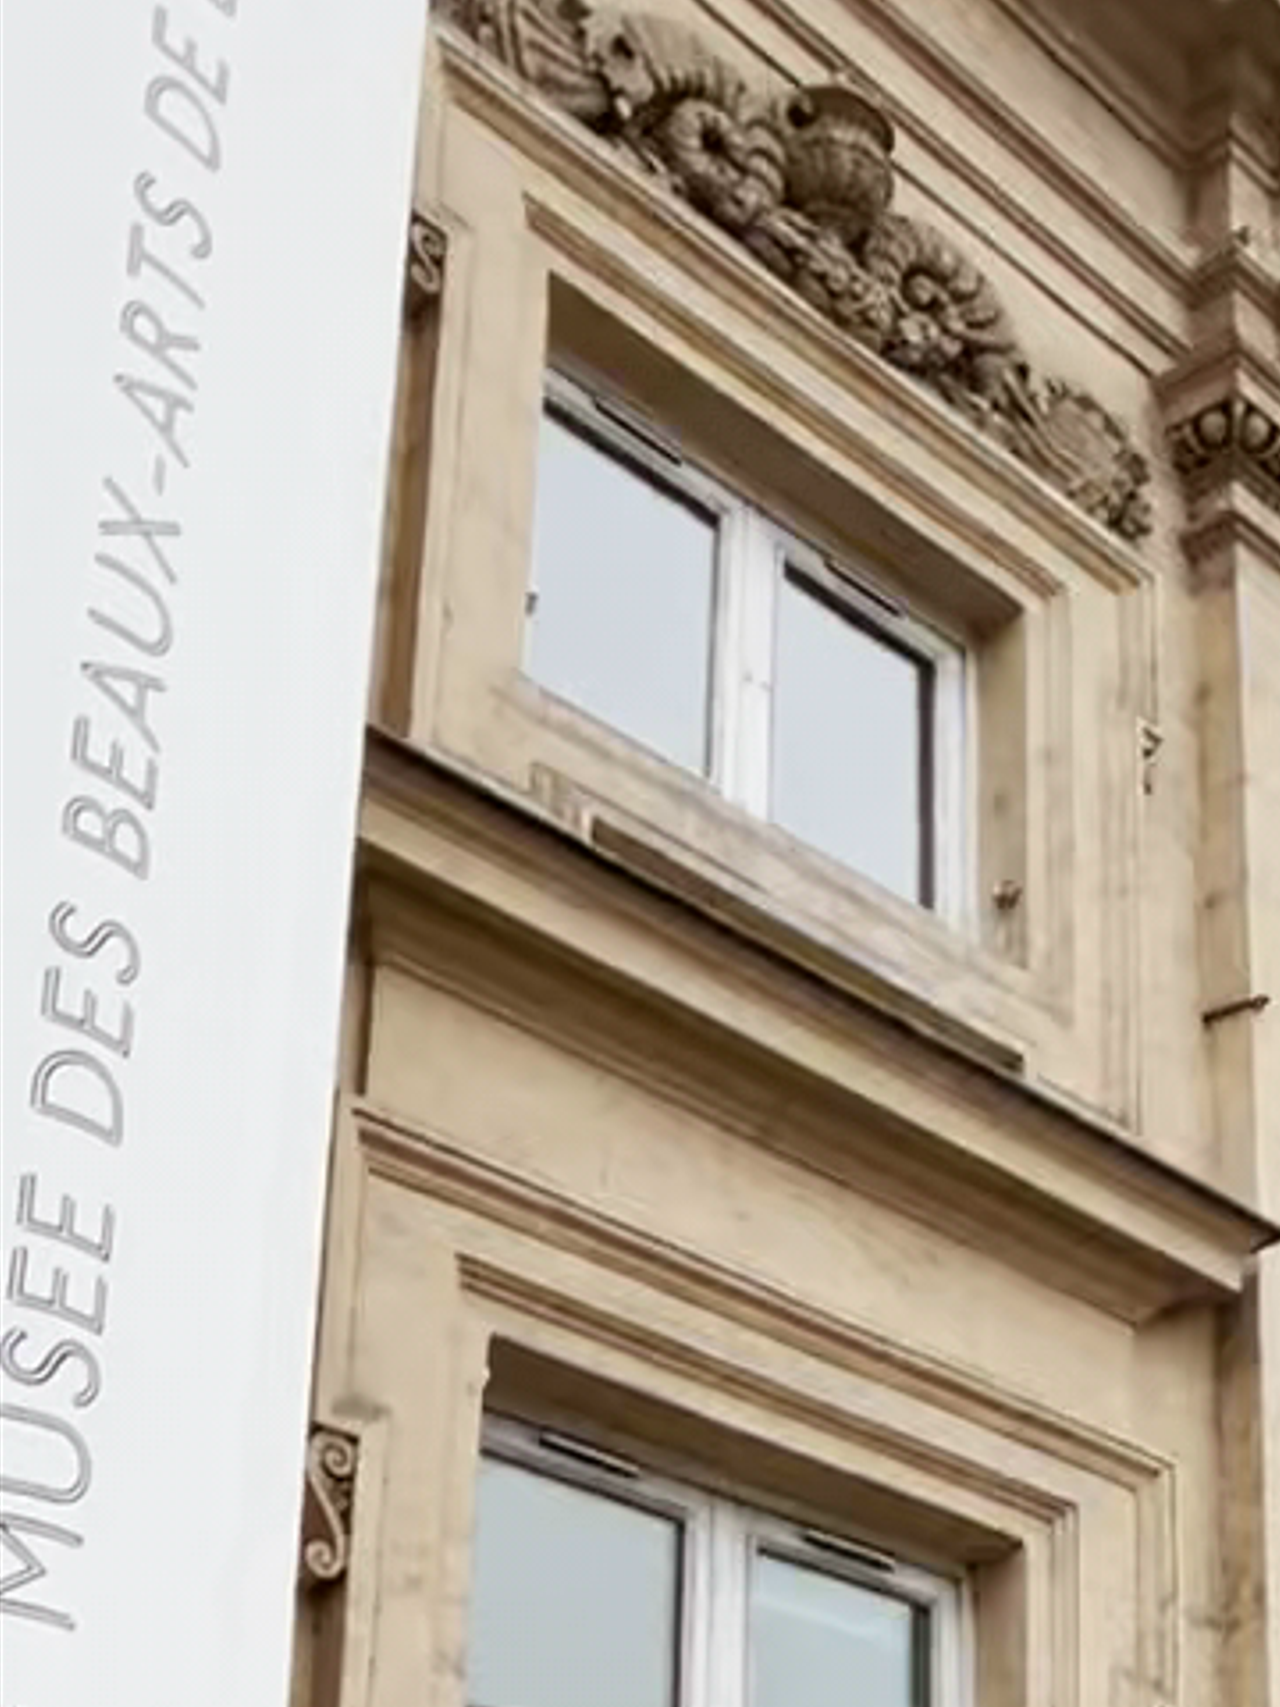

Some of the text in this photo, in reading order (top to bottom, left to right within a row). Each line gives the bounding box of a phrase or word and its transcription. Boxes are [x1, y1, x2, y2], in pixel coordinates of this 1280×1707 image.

[142, 5, 231, 173] DE
[60, 171, 213, 881] BEAUX-ARTS
[29, 901, 142, 1147] DES
[0, 1173, 117, 1632] MUSEE
